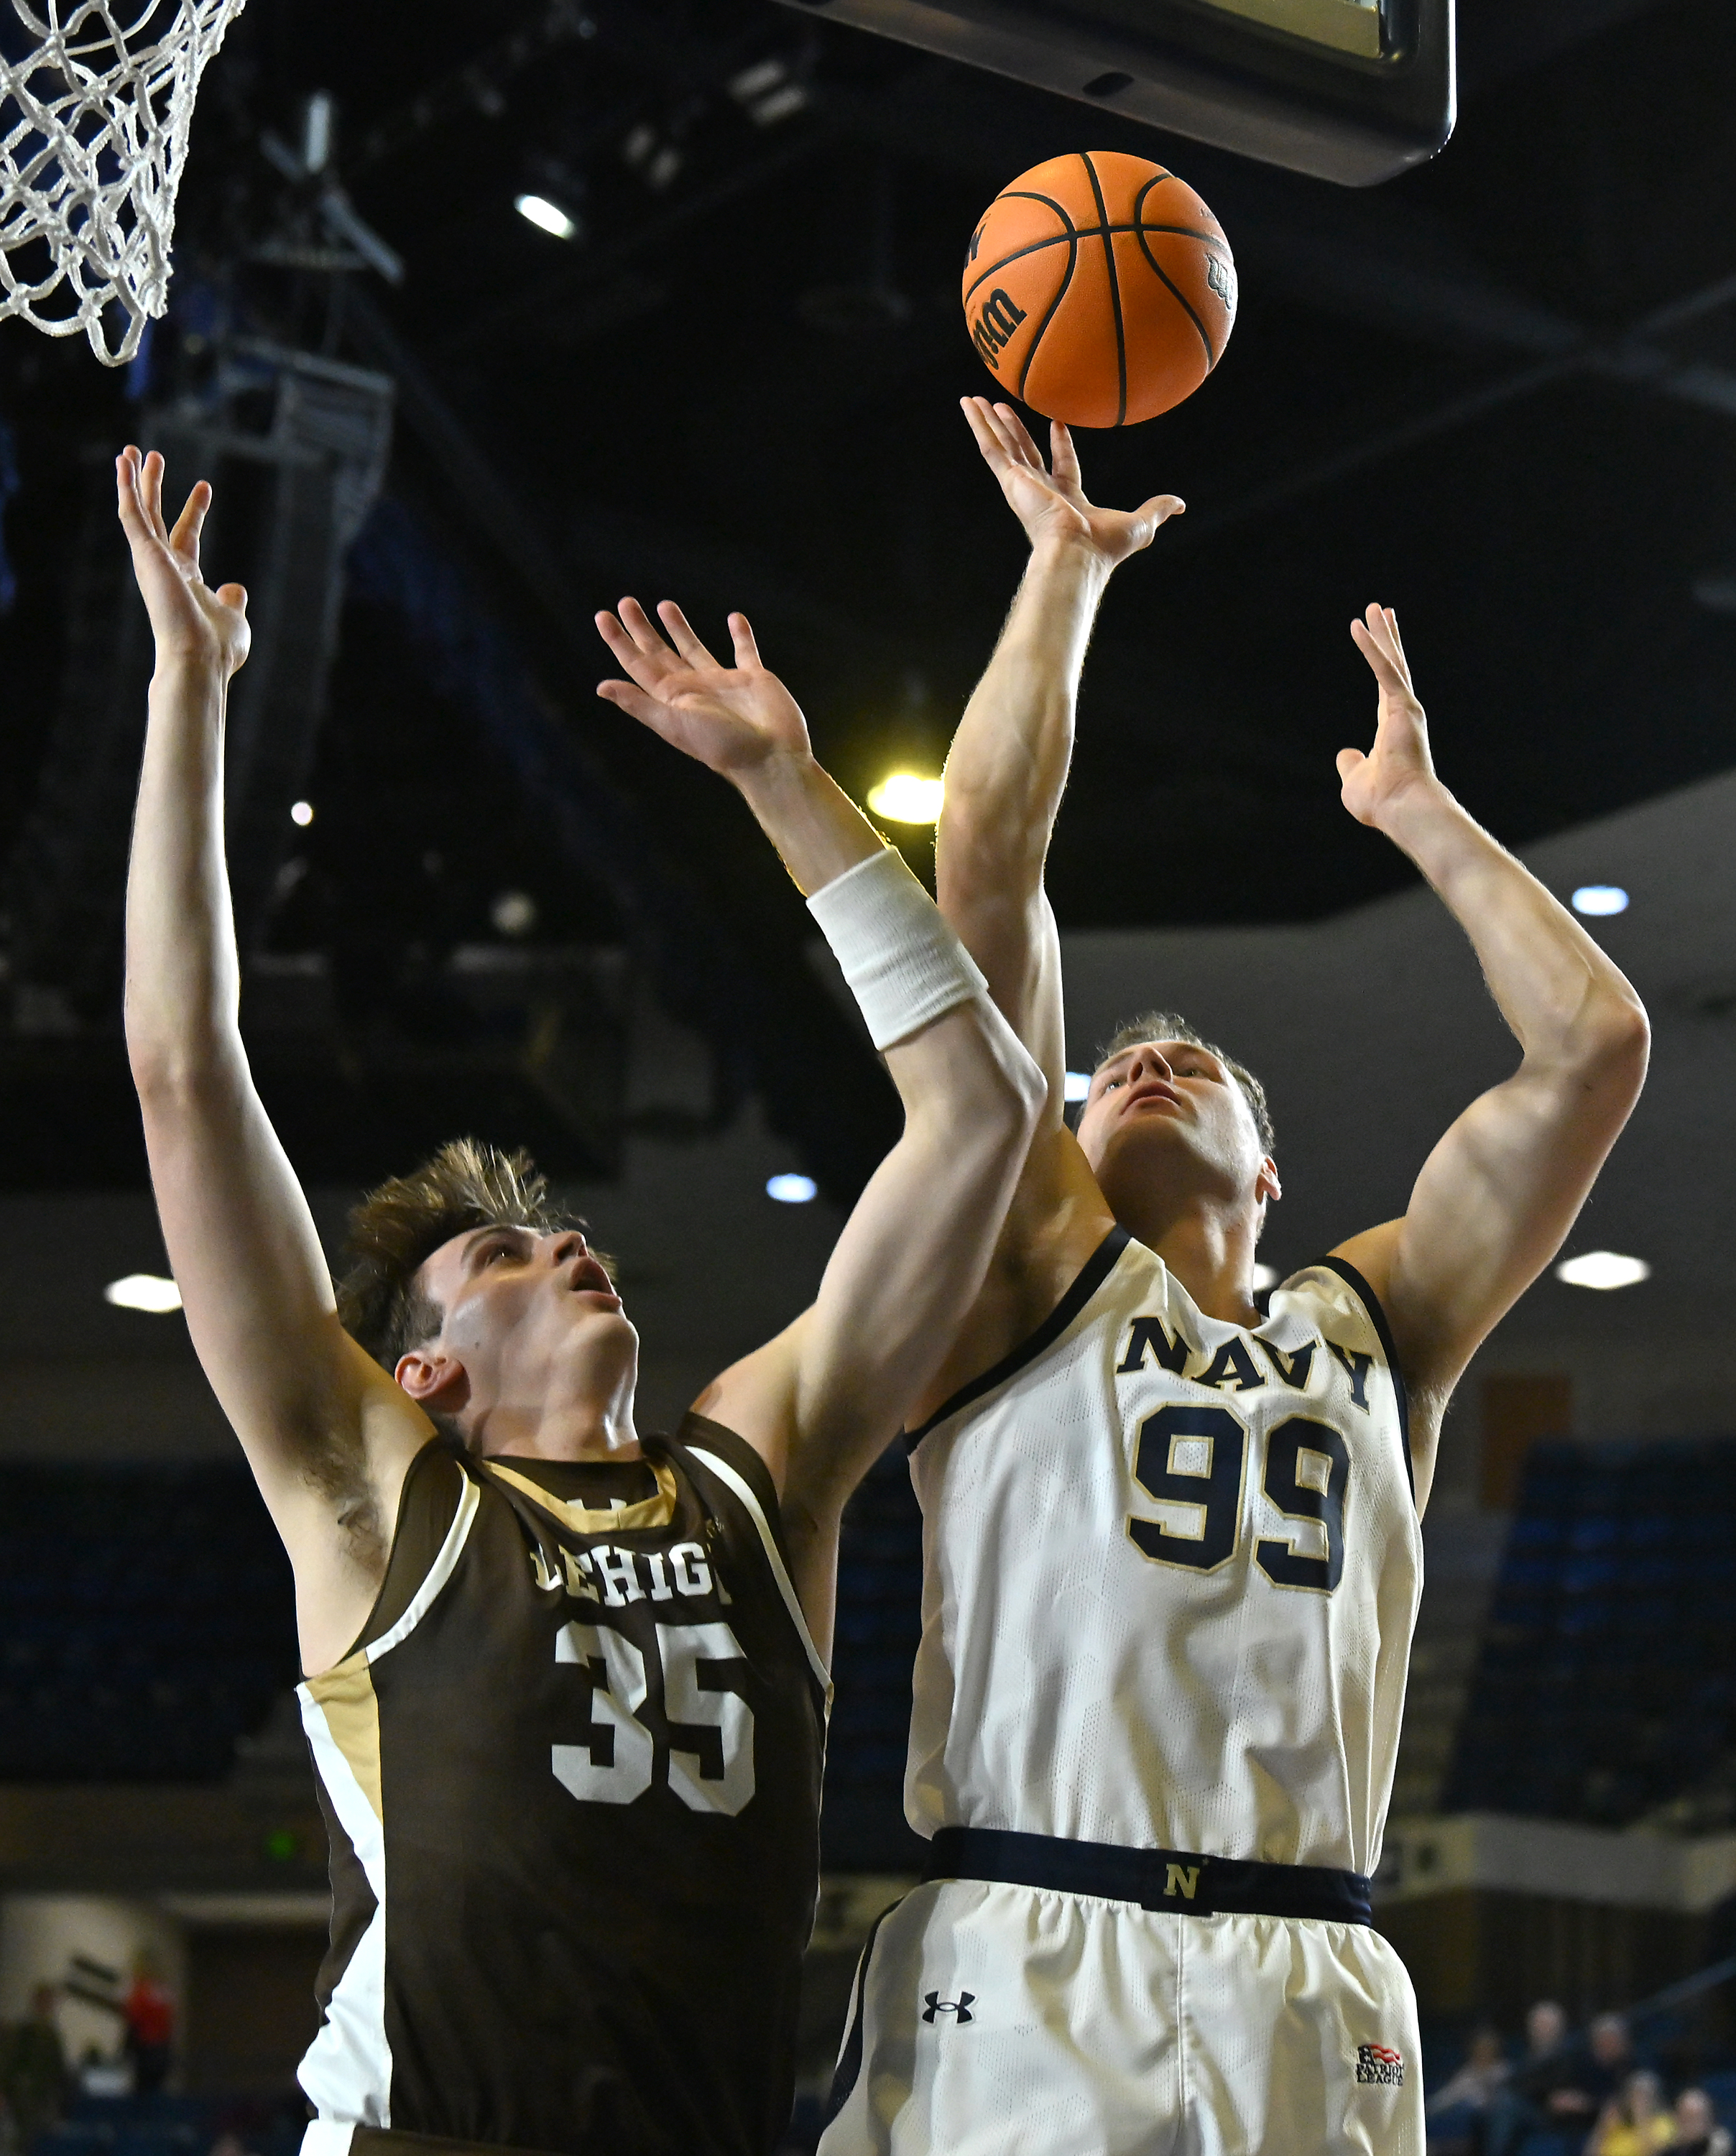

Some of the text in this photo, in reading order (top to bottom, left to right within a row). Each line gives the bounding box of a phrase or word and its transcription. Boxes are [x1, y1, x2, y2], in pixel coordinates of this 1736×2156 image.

[1115, 1317, 1374, 1415] NAVY
[1125, 1401, 1352, 1596] 99
[530, 1542, 733, 1608] LEHIG
[551, 1620, 755, 1818] 35
[1163, 1863, 1201, 1899] N
[1357, 2072, 1403, 2086] LEAGUE
